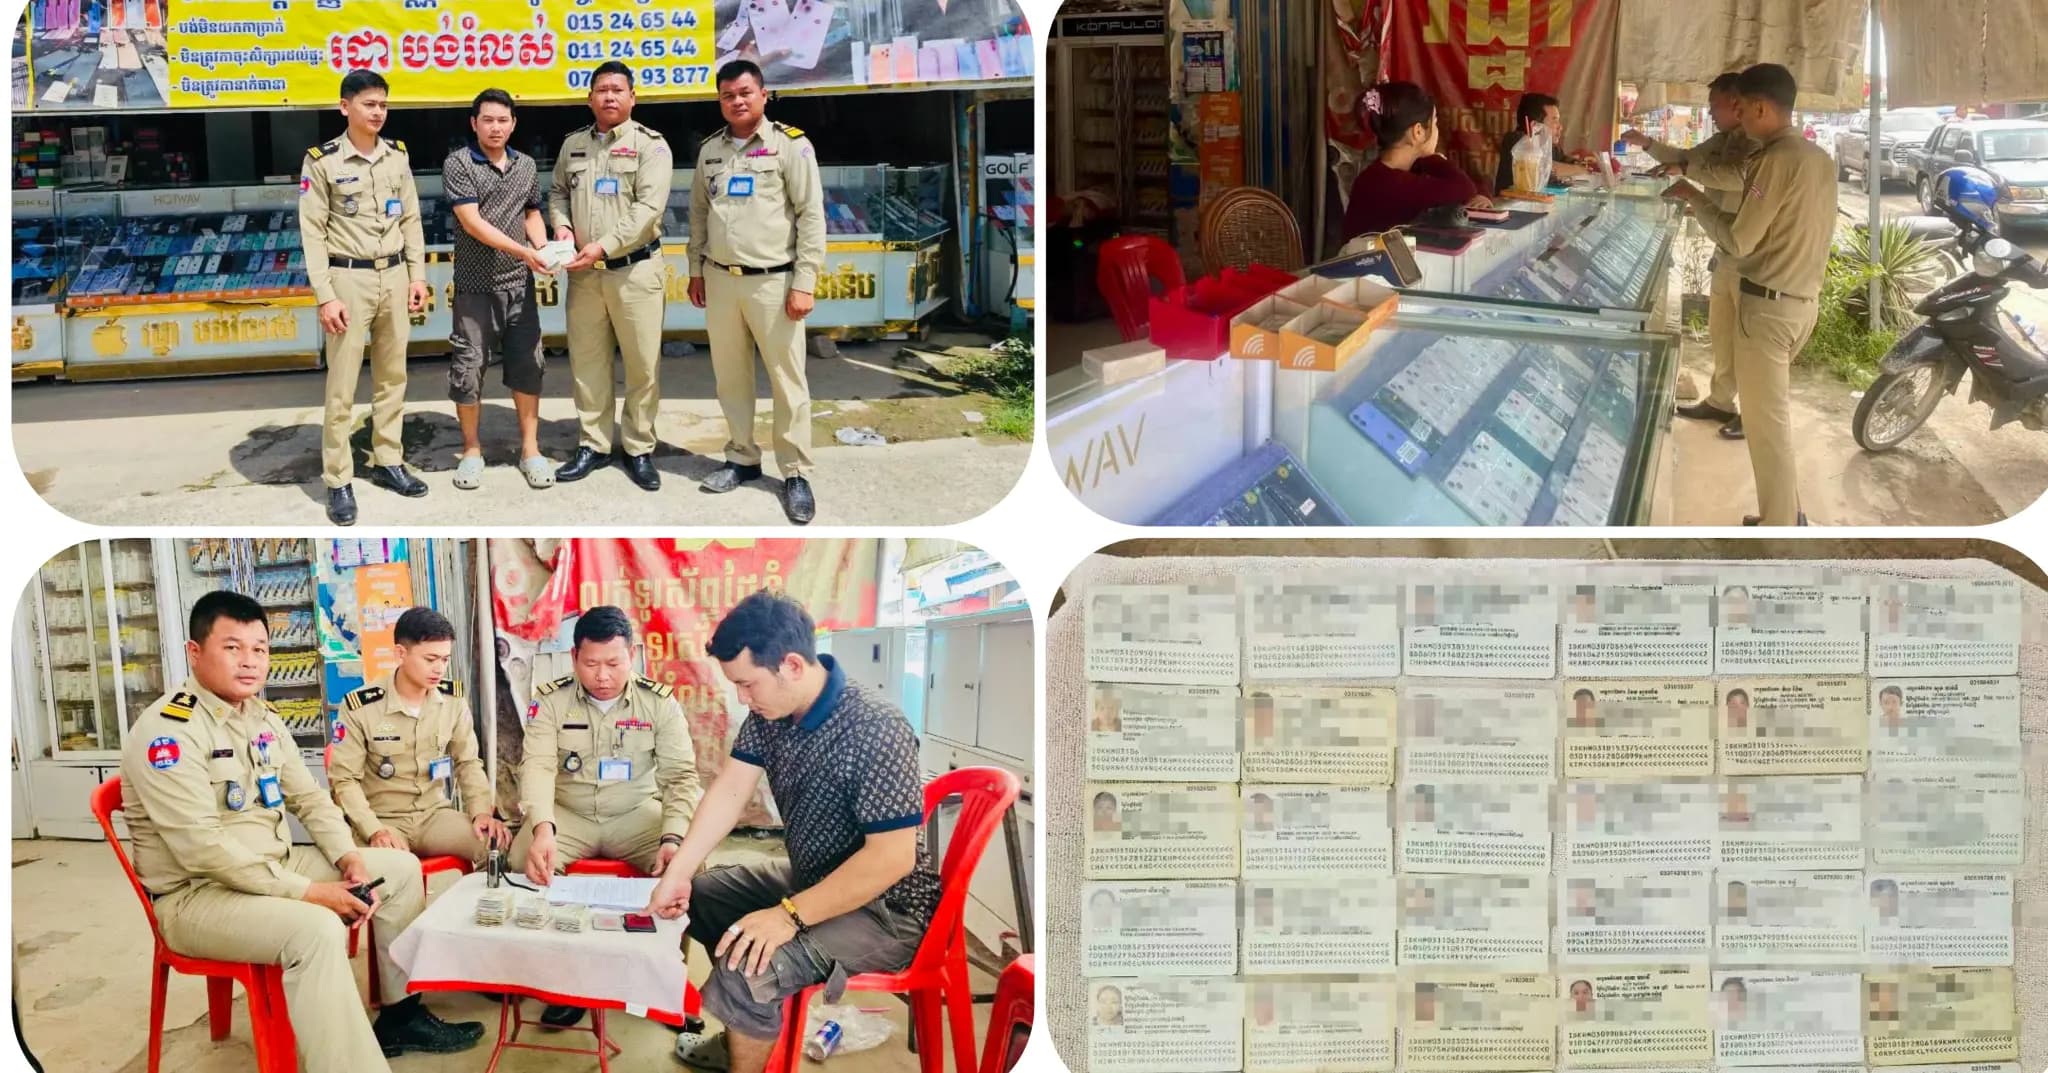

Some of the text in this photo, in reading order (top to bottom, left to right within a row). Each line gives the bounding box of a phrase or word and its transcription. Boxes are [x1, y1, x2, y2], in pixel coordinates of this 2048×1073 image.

[568, 11, 696, 30] 015 24 65 44
[568, 39, 696, 59] 011 24 65 44
[568, 67, 709, 87] 07 93 877
[986, 162, 1029, 175] GOLF
